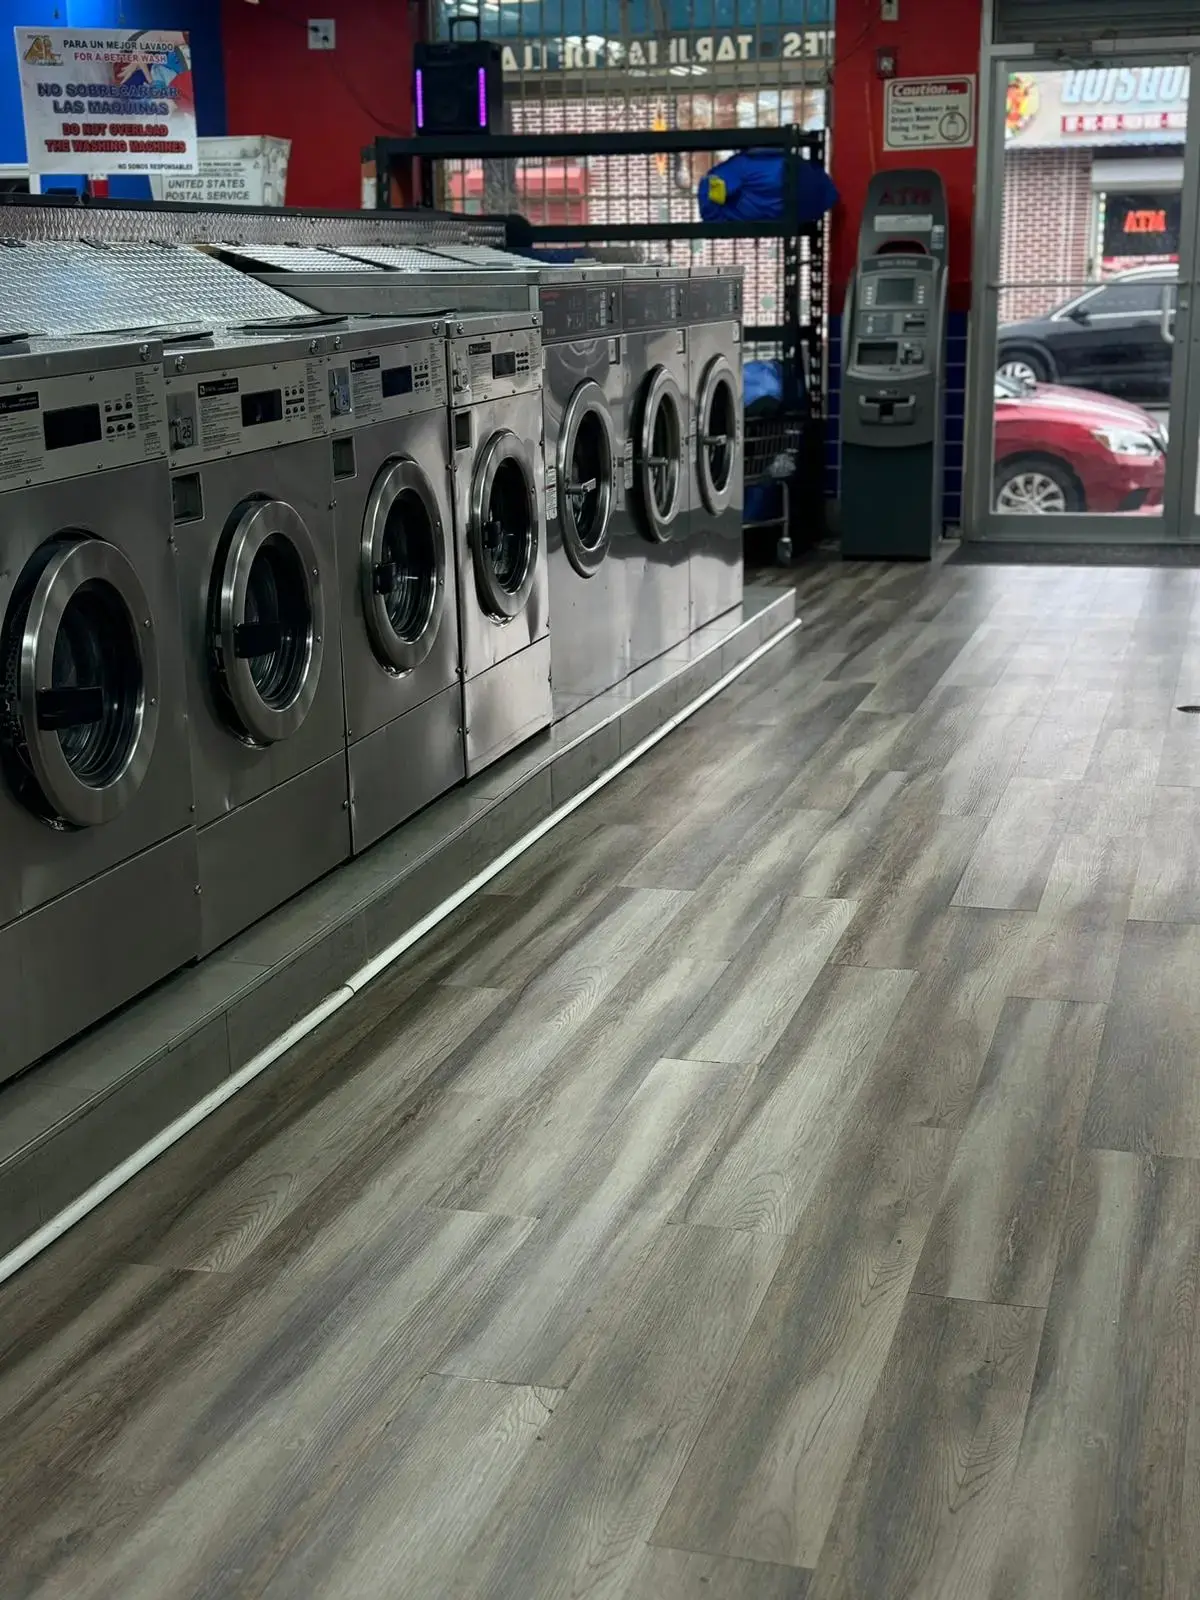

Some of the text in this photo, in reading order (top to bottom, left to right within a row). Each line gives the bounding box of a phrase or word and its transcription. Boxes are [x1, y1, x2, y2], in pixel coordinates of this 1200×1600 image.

[63, 40, 88, 49] PARA
[90, 40, 104, 49] UN
[106, 41, 137, 50] MEJOR
[74, 52, 167, 63] FOR A BETTER WASH
[37, 83, 178, 98] NO SOBRECARGAR
[53, 100, 170, 116] LAS MAQUINAS
[62, 123, 169, 137] DO NOT OVERLOAD
[45, 140, 186, 153] THE WASHING MACHINES
[168, 179, 245, 189] UNITED STATES
[165, 191, 250, 200] POSTAL SERVICE
[1123, 210, 1166, 233] ATM
